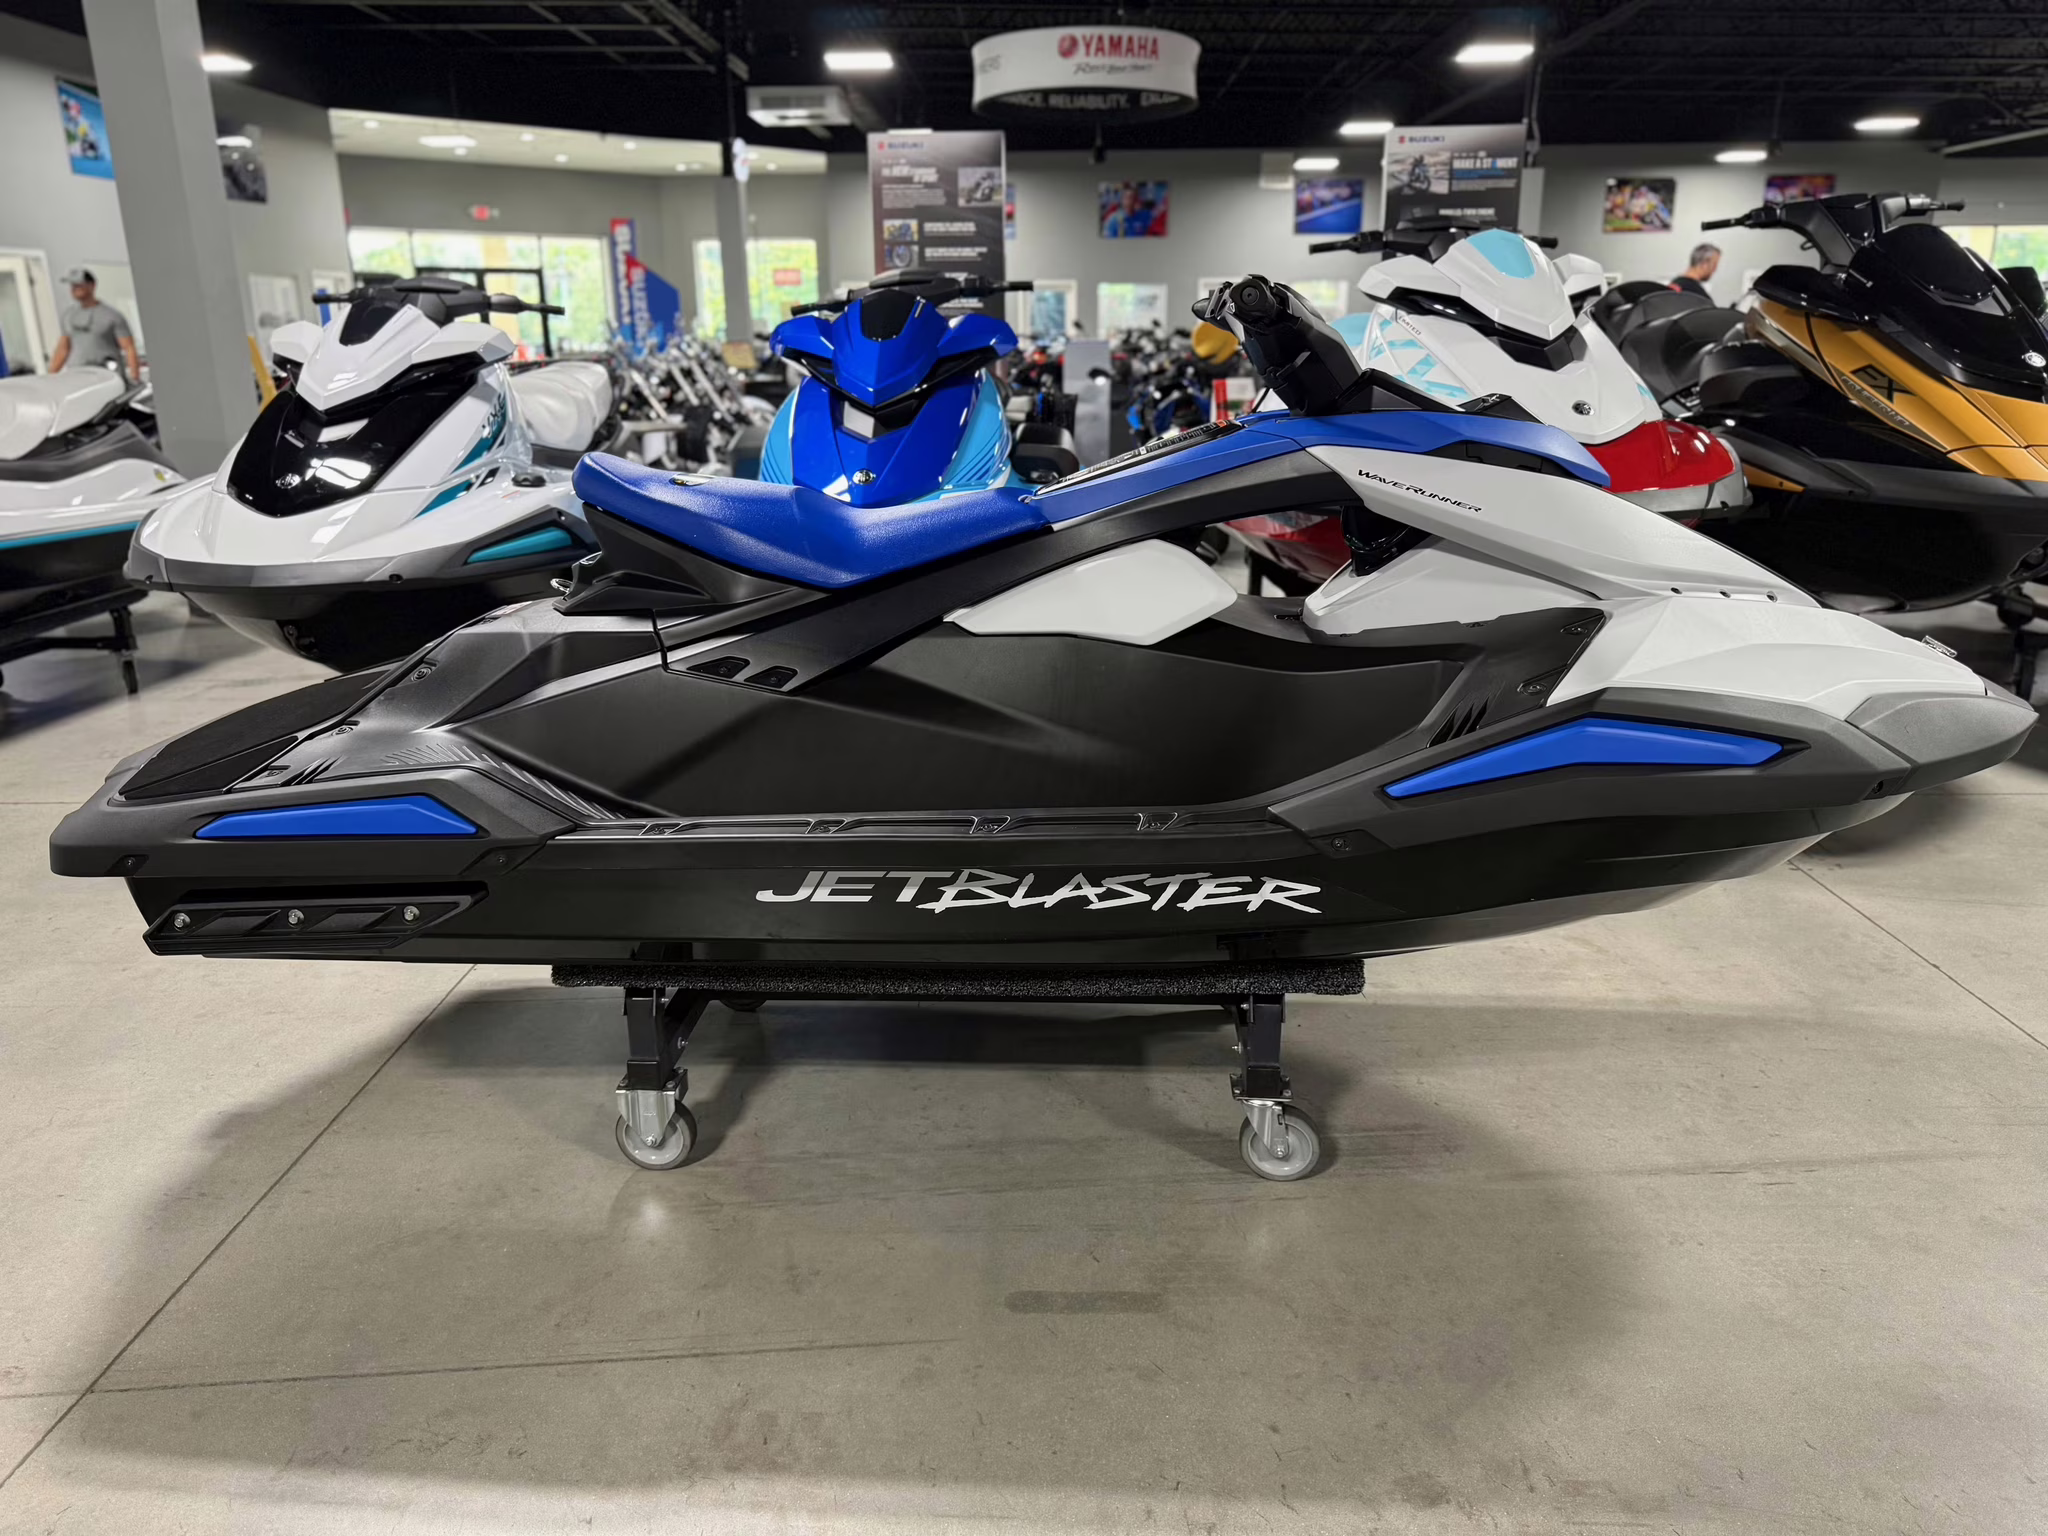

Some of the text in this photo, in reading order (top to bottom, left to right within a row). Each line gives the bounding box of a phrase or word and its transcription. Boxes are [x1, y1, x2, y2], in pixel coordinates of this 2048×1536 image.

[1081, 34, 1160, 60] YAMAHA
[1408, 135, 1446, 144] SUZUKI
[1358, 469, 1482, 513] WAVERUNNER
[755, 867, 1322, 914] JETBLASTER
